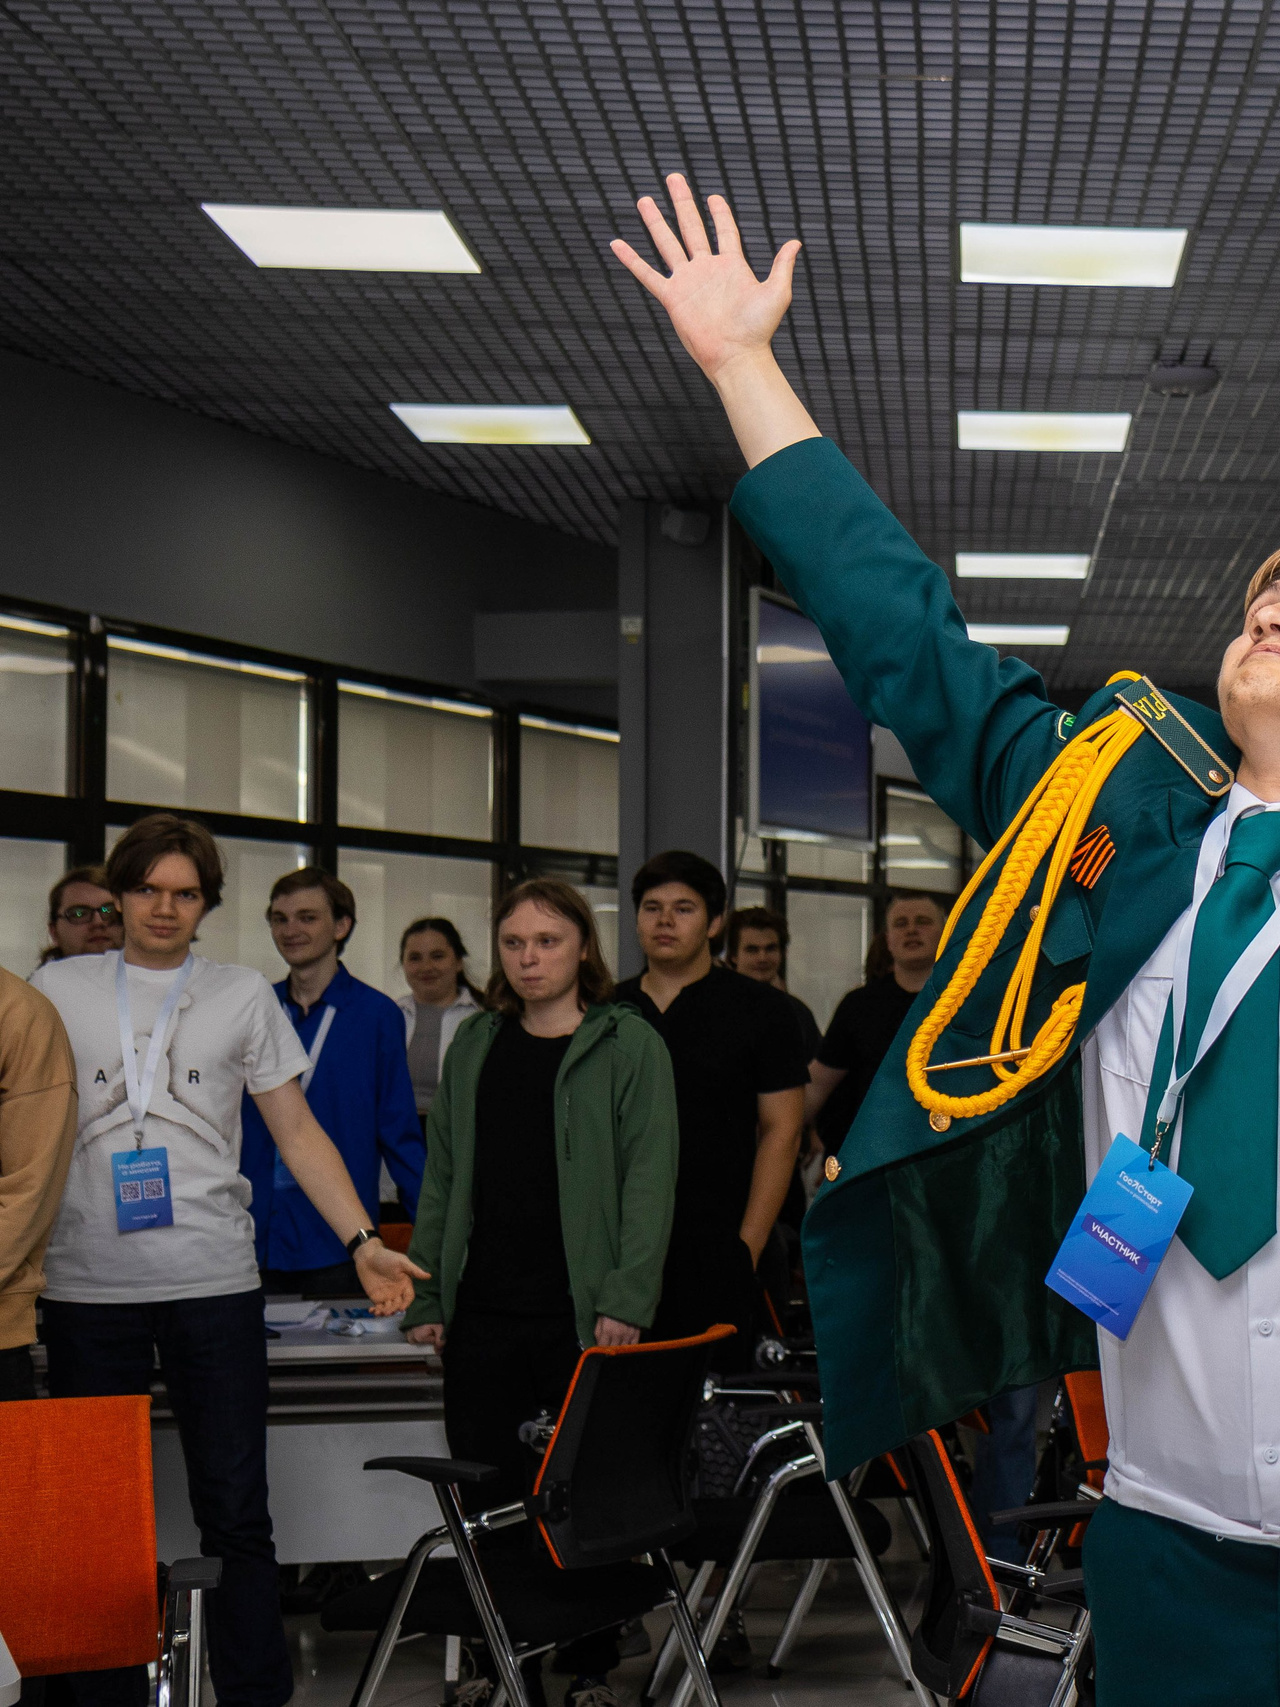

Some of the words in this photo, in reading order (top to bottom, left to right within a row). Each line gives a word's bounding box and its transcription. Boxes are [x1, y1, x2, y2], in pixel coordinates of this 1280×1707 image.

[94, 1069, 107, 1083] A
[188, 1069, 200, 1084] R
[1091, 1222, 1141, 1265] УЧАСТНИК
